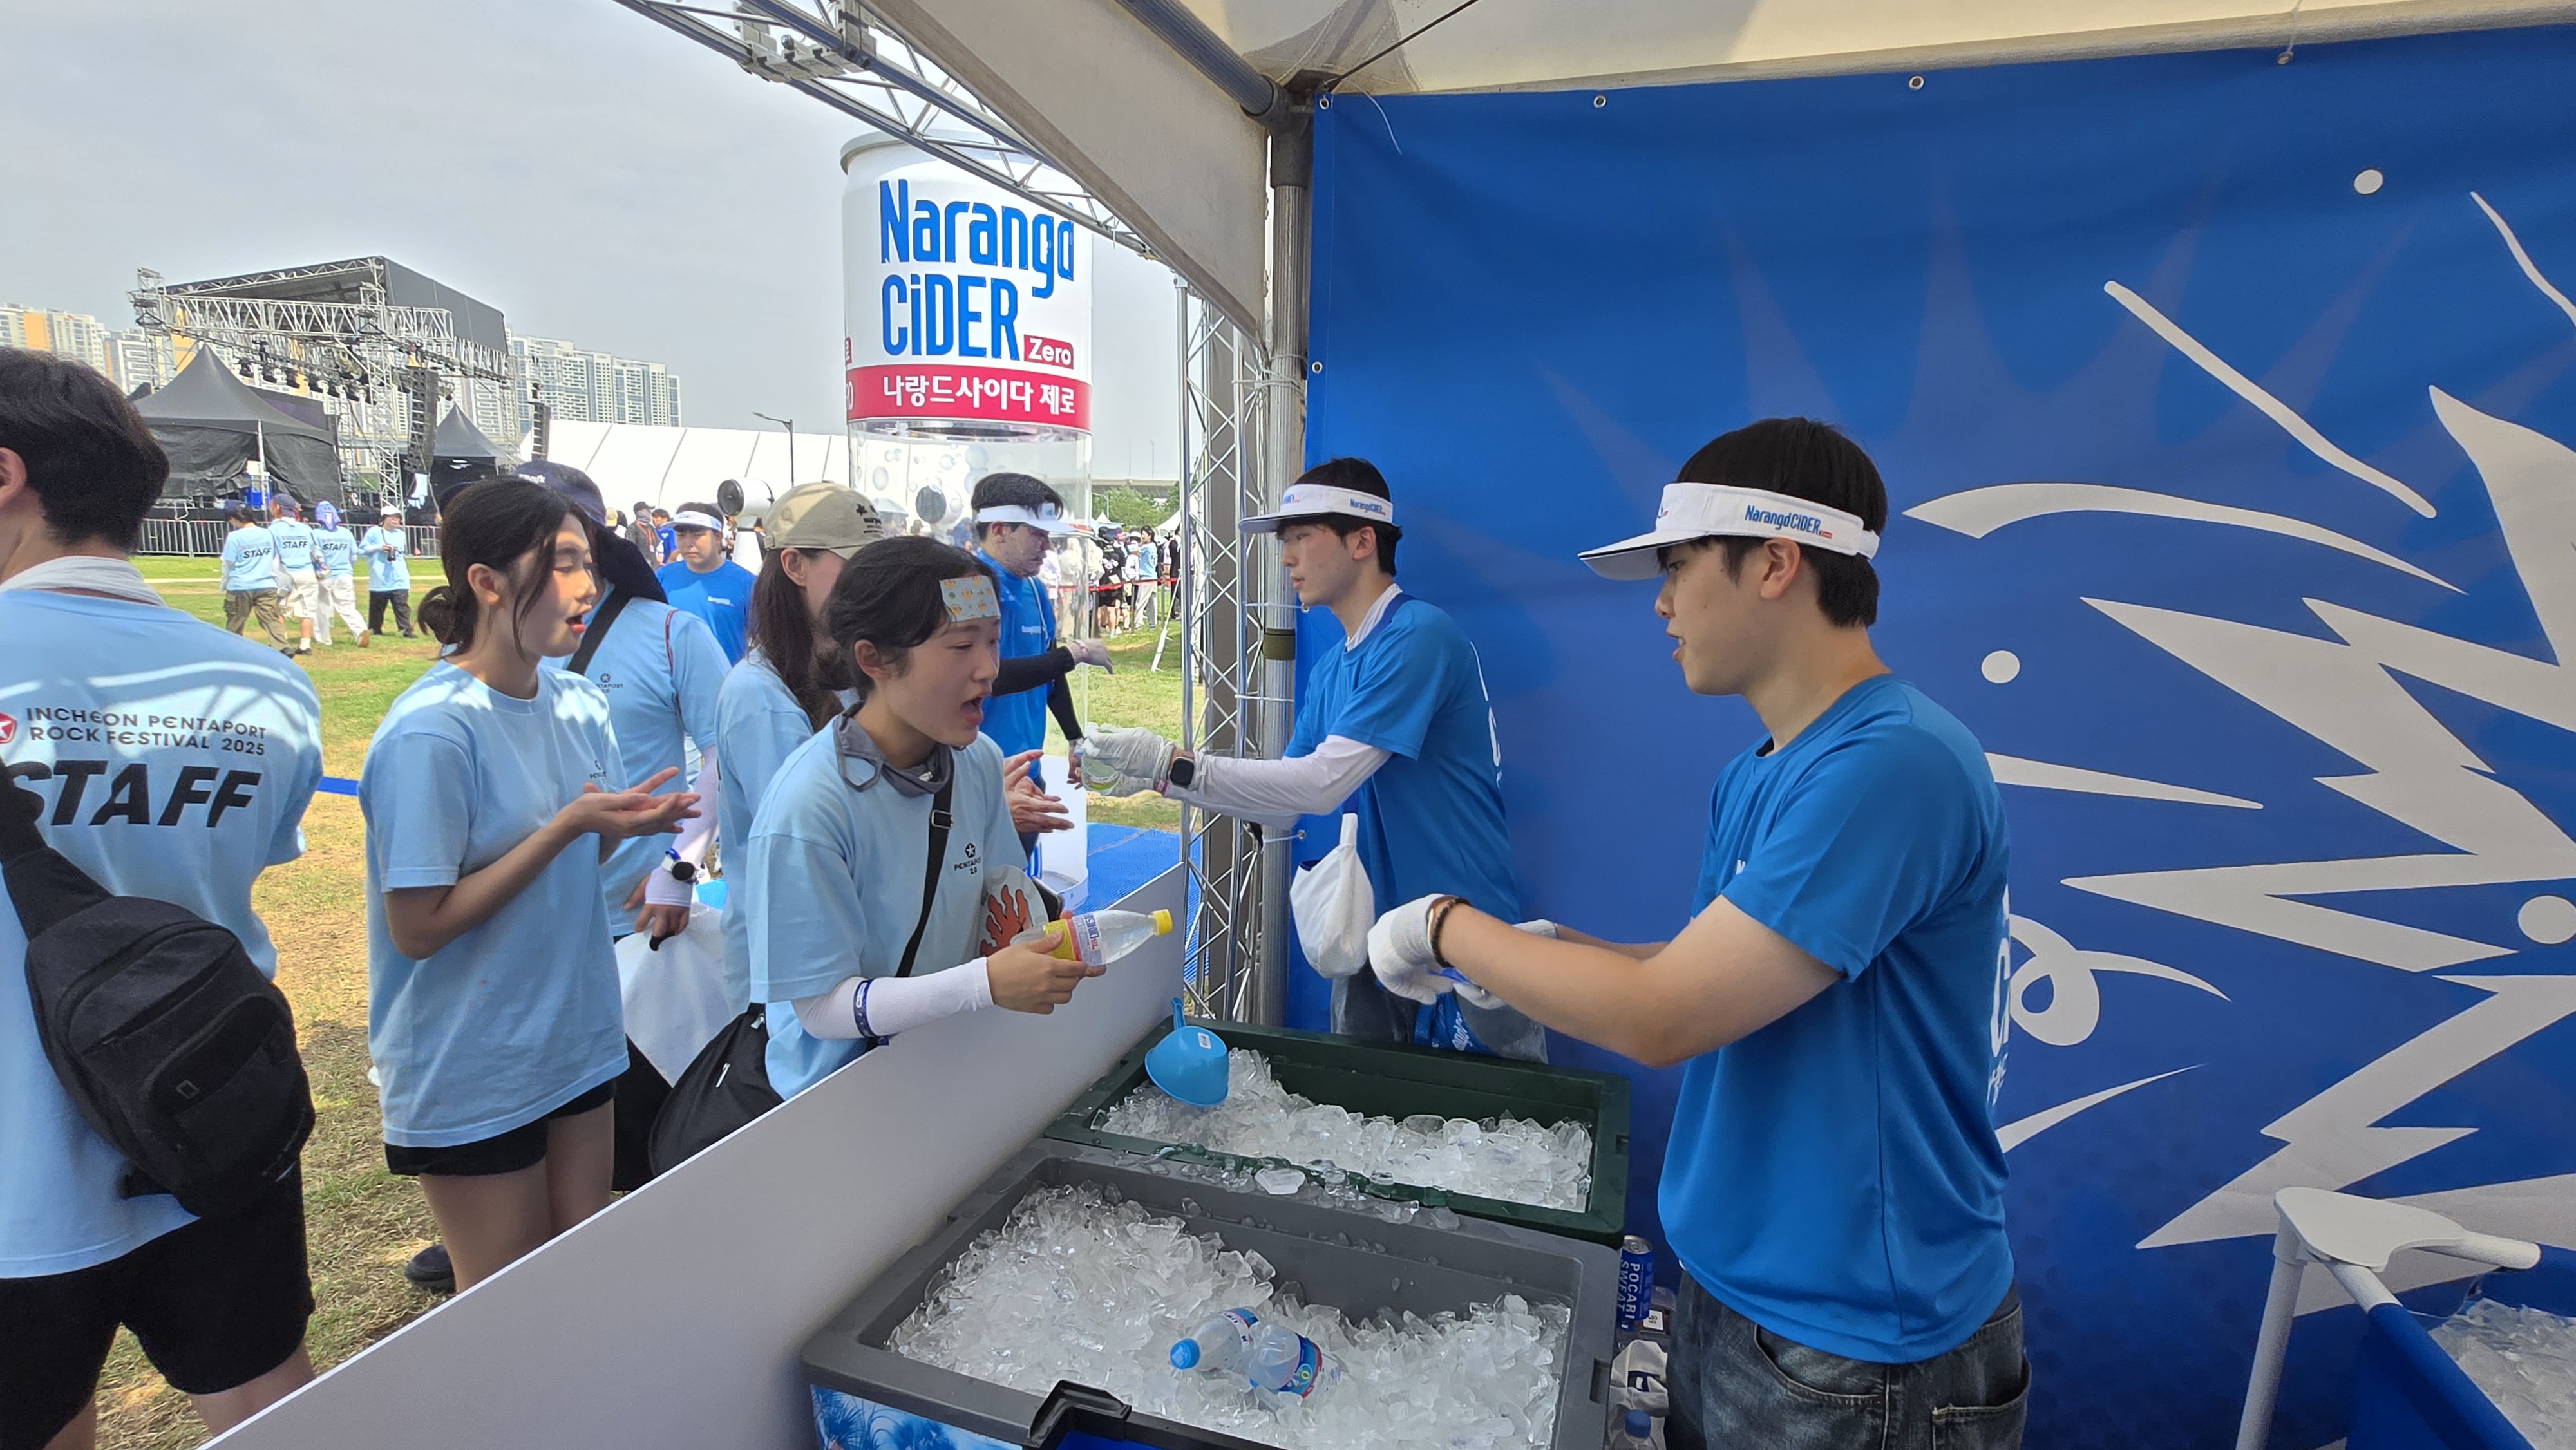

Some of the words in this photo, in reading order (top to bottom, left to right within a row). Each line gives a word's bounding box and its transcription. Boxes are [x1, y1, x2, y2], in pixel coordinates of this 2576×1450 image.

[1028, 339, 1072, 365] Zero
[883, 375, 1034, 412] 나랑드사이다
[1039, 384, 1075, 415] 제로
[243, 547, 272, 559] STAFF
[27, 707, 138, 728] INCHEON
[149, 715, 267, 740] PENTAPORT
[30, 726, 100, 742] ROCK
[107, 730, 210, 749] FESTIVAL
[221, 739, 265, 756] 2025
[5, 760, 261, 831] STAFF
[1618, 1260, 1629, 1312] SWEAT
[1625, 1262, 1641, 1319] POCARI
